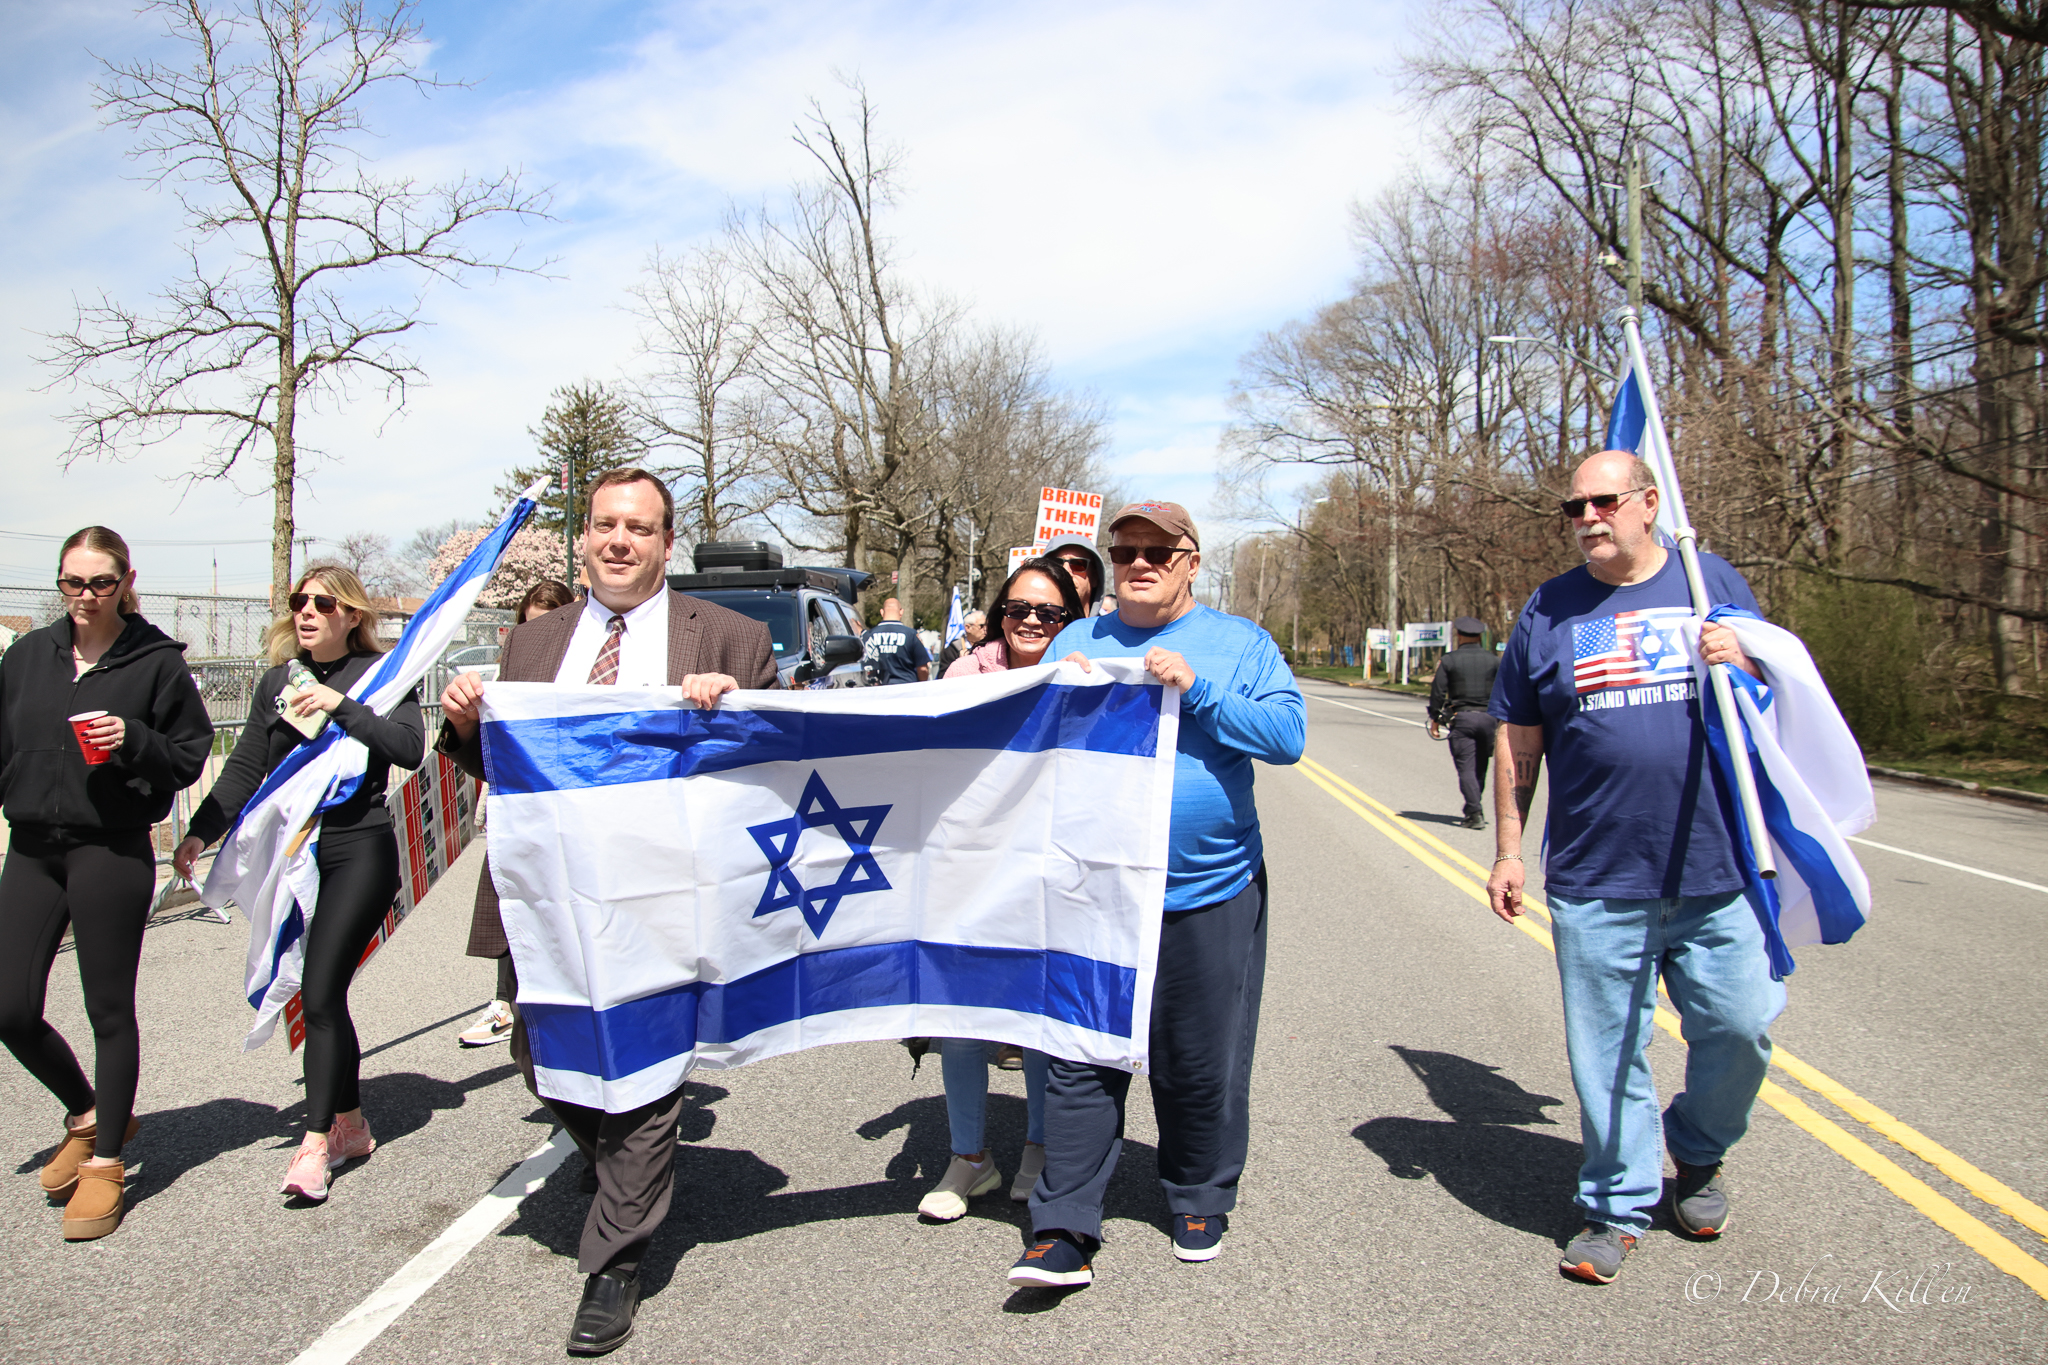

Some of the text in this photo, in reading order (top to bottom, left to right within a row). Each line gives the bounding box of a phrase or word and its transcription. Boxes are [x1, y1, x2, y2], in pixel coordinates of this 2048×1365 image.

[1042, 487, 1102, 508] BRING
[1044, 507, 1095, 527] THEM
[873, 633, 906, 646] NYPD
[1586, 690, 1624, 711] STAND
[1627, 685, 1663, 706] WITH
[1665, 682, 1697, 702] ISRA
